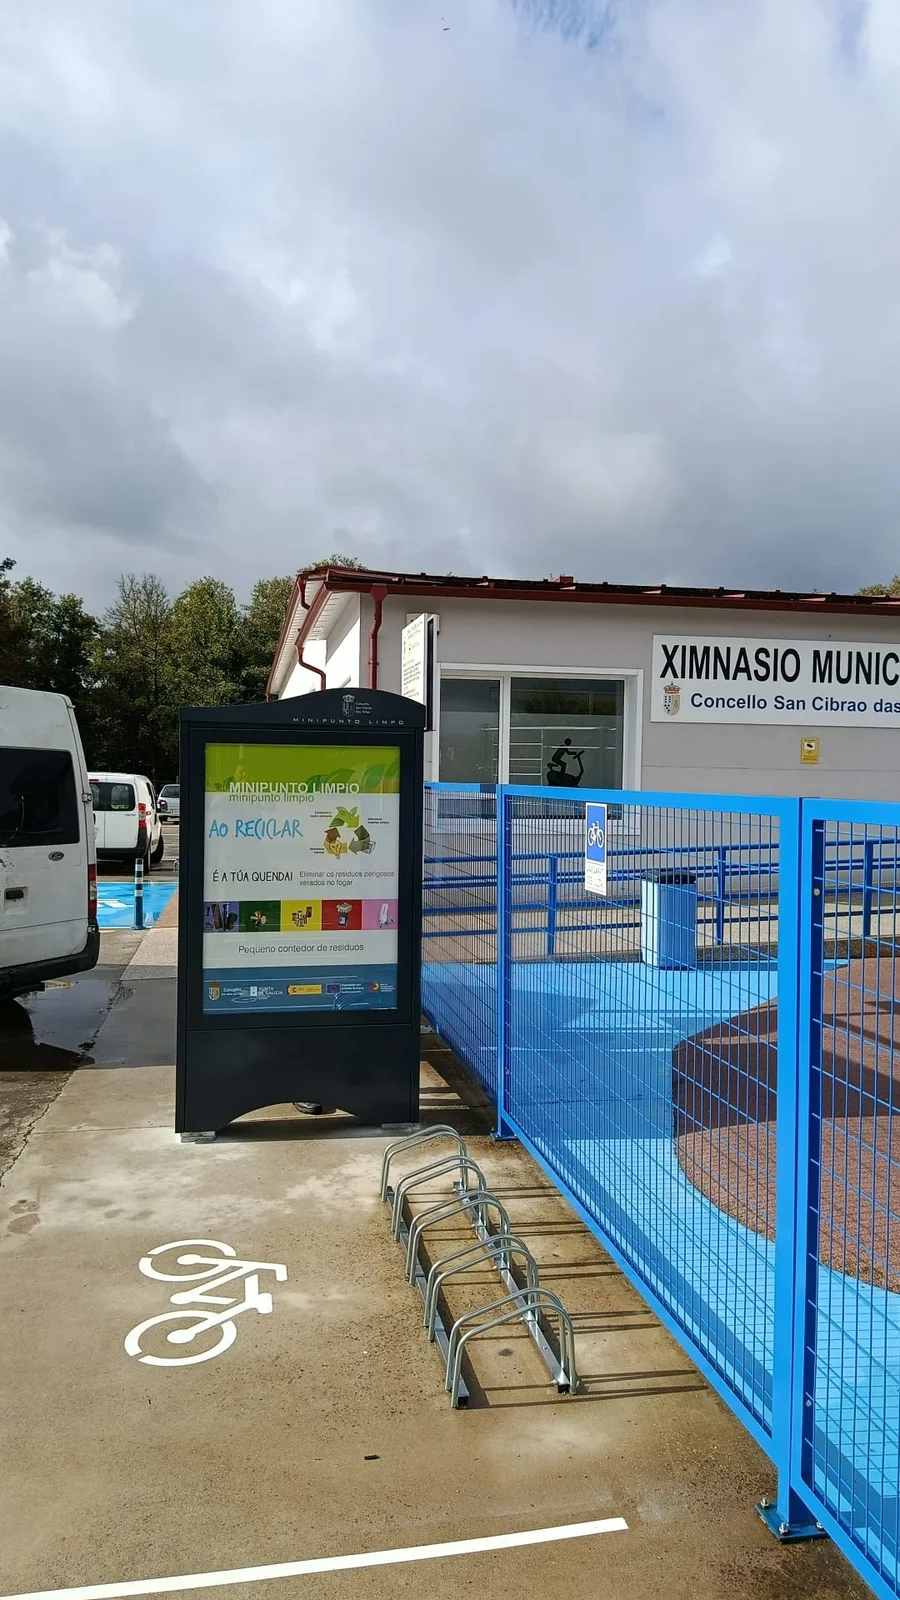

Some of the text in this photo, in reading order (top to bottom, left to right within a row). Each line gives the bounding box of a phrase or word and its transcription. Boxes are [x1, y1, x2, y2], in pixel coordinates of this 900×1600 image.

[660, 644, 900, 686] XIMNASIO MUNIC
[690, 693, 900, 713] Concello San Cibrao das
[292, 717, 360, 725] MINIPUNTO
[229, 782, 308, 794] MINIPUNTO
[229, 792, 315, 804] minipunto limpio
[235, 818, 304, 840] RECICLAR
[212, 870, 219, 882] É
[221, 872, 228, 882] A
[230, 870, 250, 882] TÚA
[300, 870, 325, 878] Eliminar
[336, 879, 353, 887] fogar
[238, 943, 365, 955] Pequeno contedor de residuos
